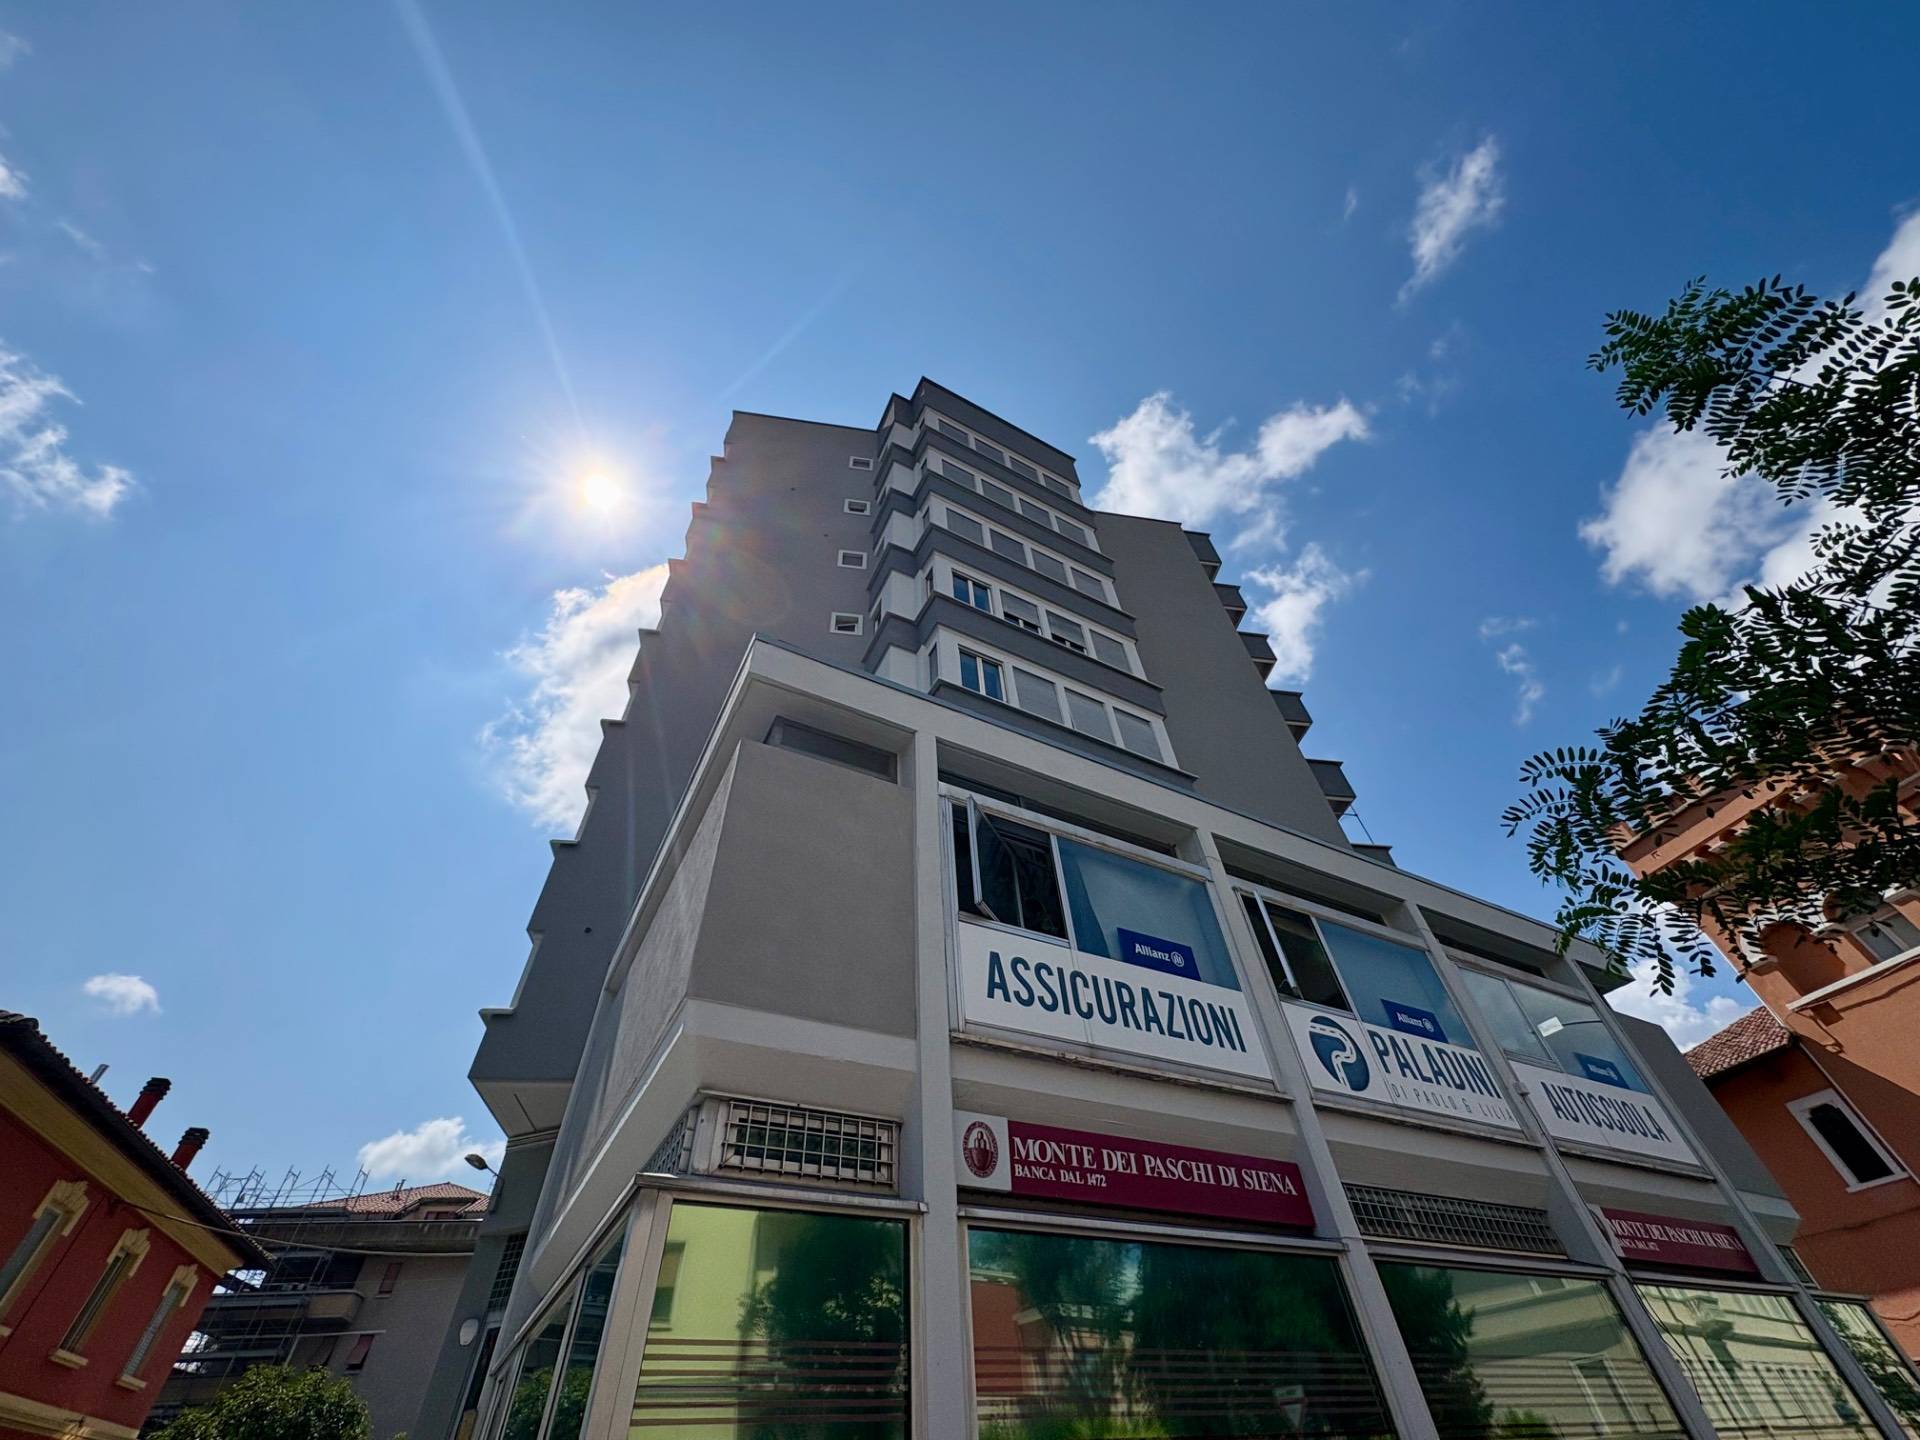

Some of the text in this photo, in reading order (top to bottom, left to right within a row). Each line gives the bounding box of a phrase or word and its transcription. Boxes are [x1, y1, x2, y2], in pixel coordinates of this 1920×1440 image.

[1134, 943, 1171, 962] Allianz
[986, 950, 1247, 1053] ASSICURAZIONI
[1367, 1029, 1503, 1100] PALADINI
[1391, 1083, 1408, 1099] DI
[1540, 1081, 1673, 1143] AUTOSCUOLA
[1012, 1136, 1097, 1169] MONTE
[1100, 1148, 1139, 1175] DEI
[1142, 1154, 1217, 1185] PASCHI
[1217, 1165, 1240, 1188] DI
[1241, 1168, 1298, 1196] SIENA
[1014, 1163, 1107, 1187] BANCA DAL 1472
